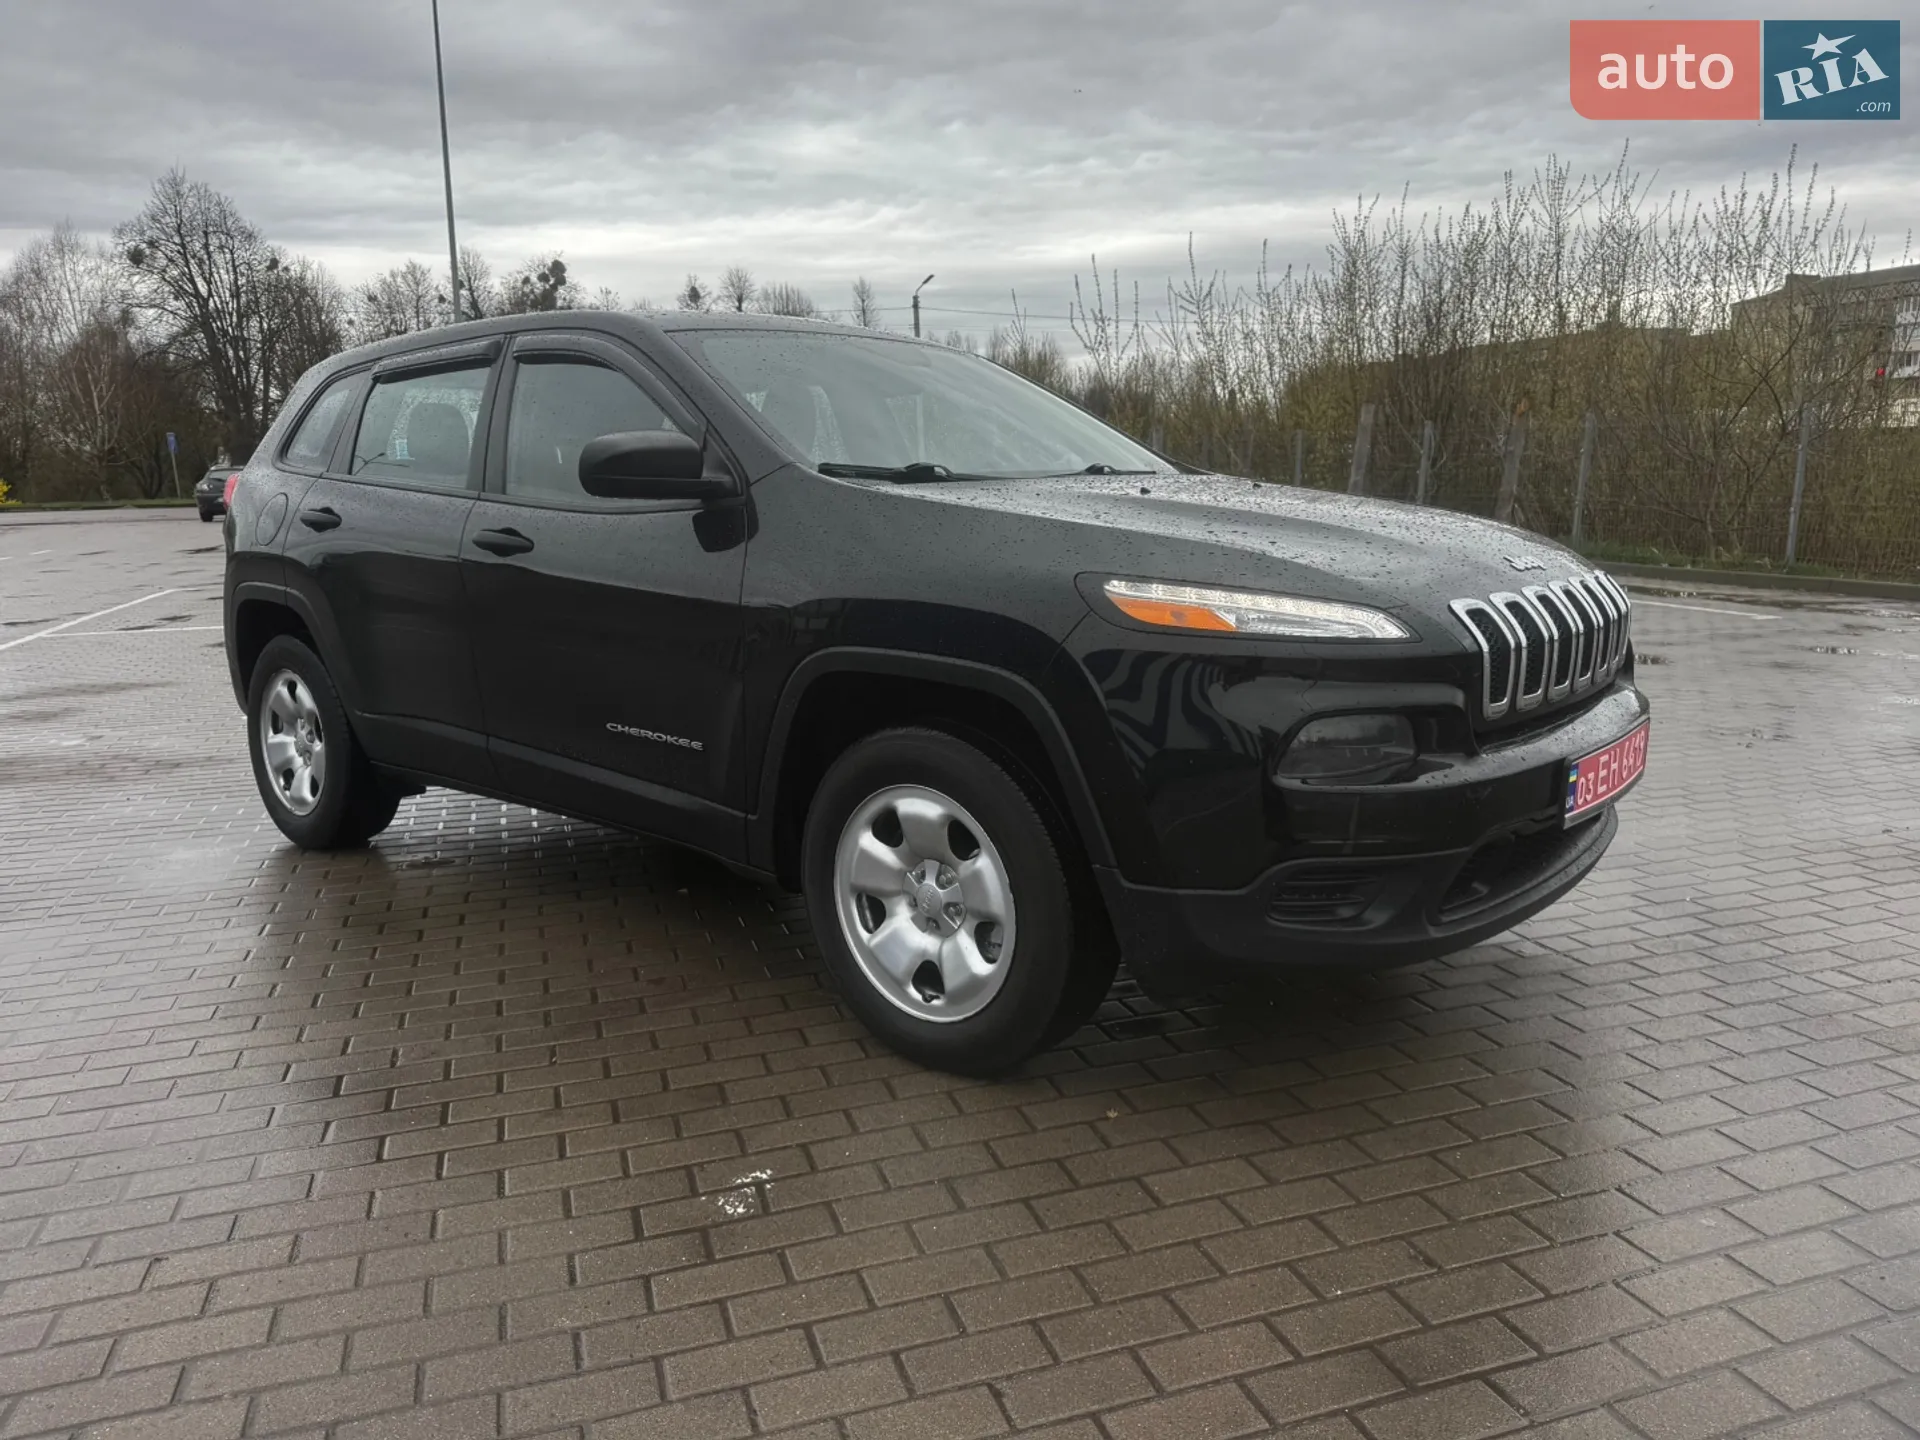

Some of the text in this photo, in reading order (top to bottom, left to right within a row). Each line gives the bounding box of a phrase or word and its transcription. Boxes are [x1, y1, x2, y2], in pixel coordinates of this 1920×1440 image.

[605, 722, 704, 751] CHEROKEE
[1577, 771, 1595, 806] 03
[1597, 748, 1620, 795] EH
